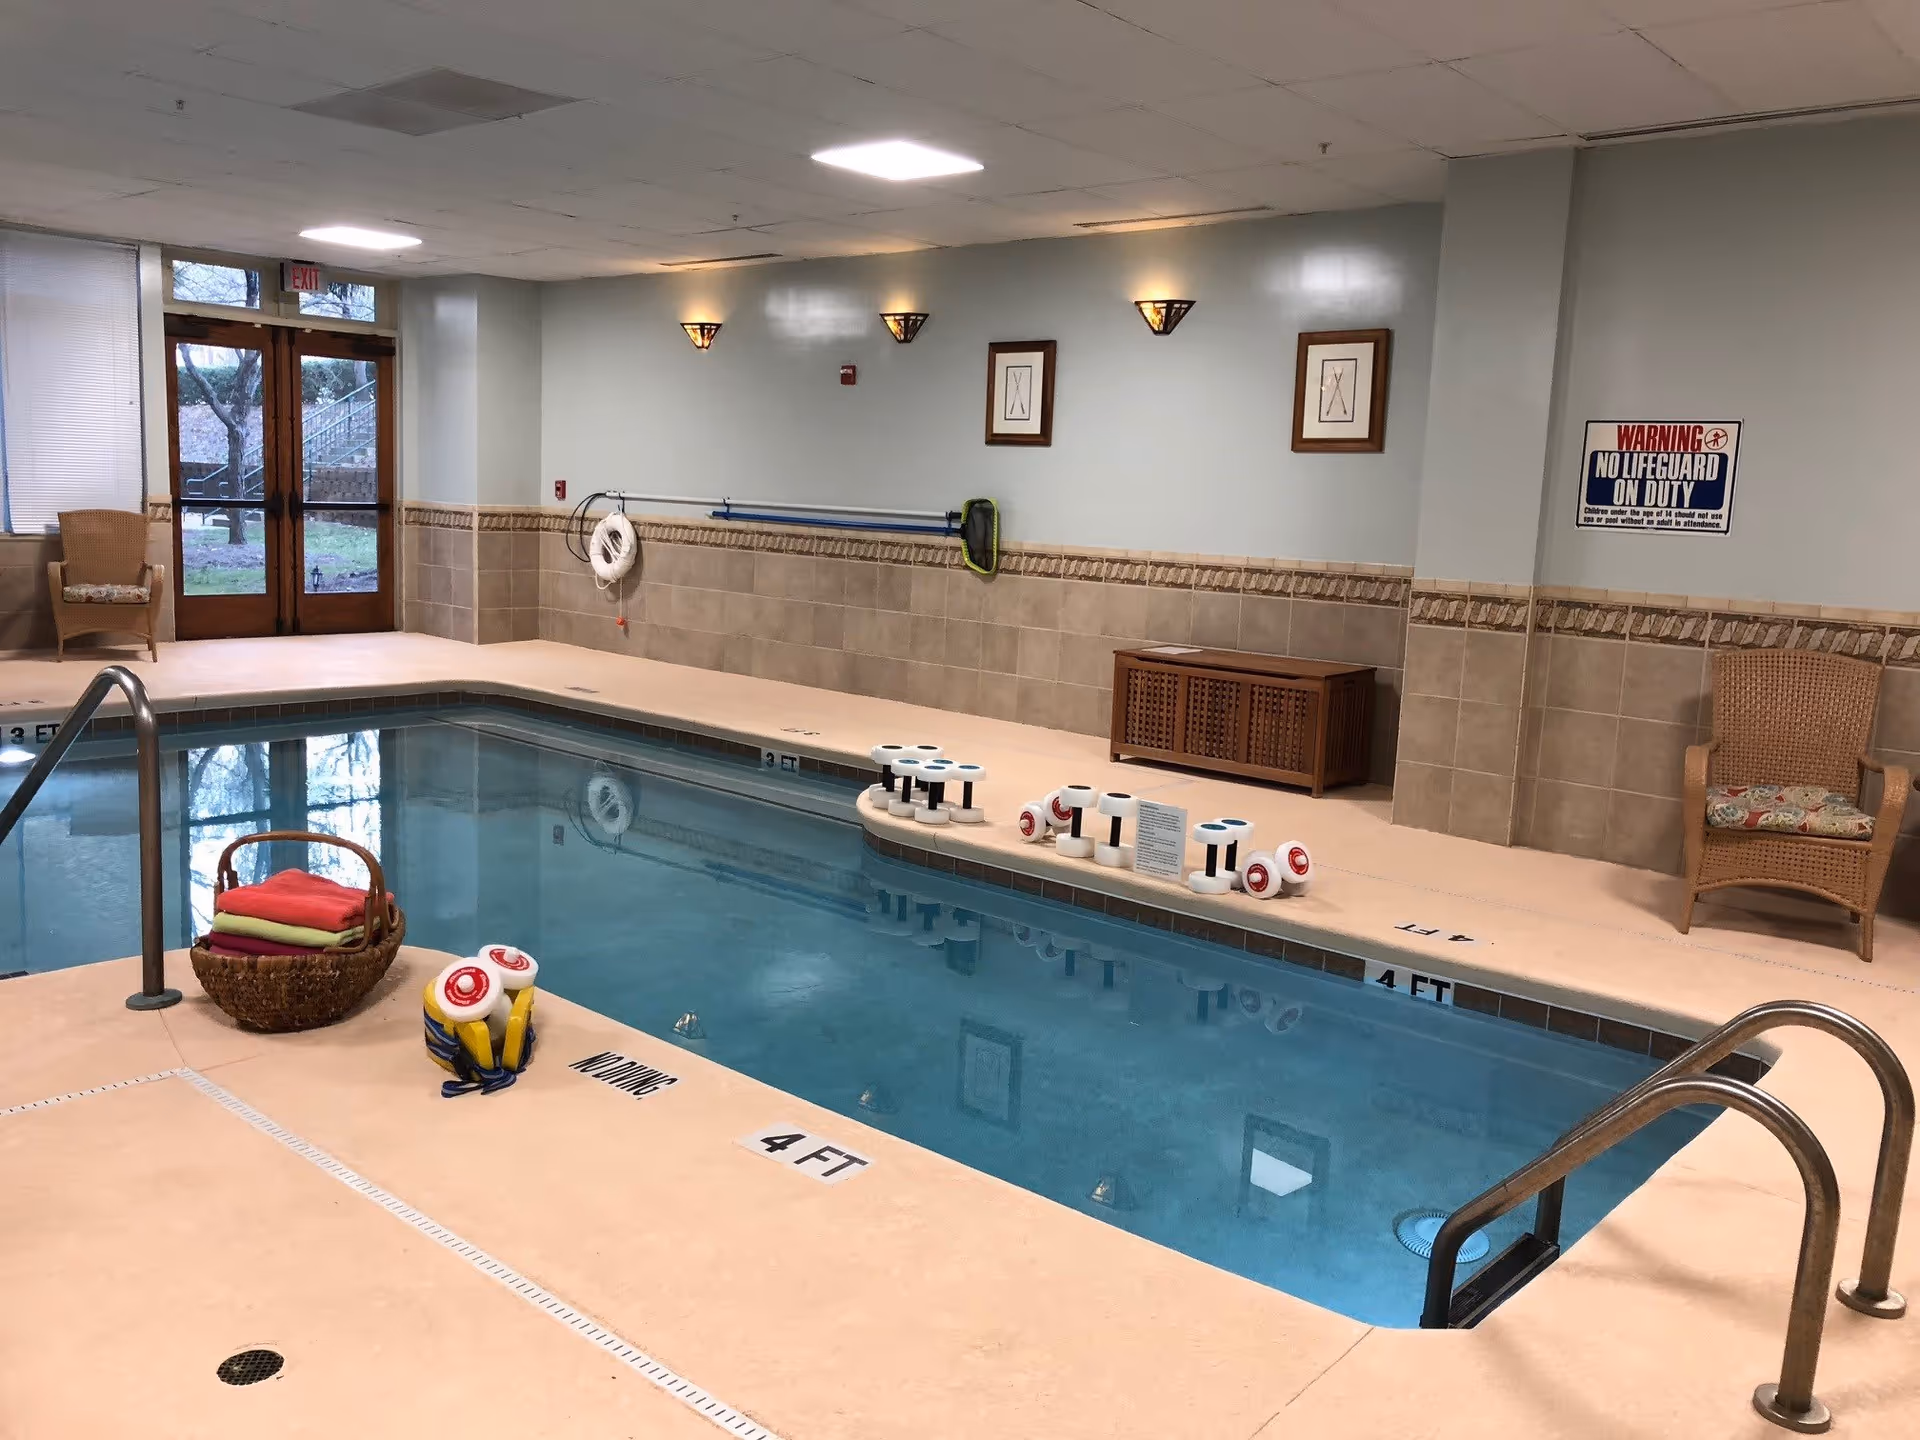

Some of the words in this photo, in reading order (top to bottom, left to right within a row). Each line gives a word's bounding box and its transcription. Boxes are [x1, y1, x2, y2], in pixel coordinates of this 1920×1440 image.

[292, 266, 319, 290] EXIT
[1617, 424, 1704, 453] WARNING
[1595, 452, 1621, 479] NO
[1622, 452, 1720, 481] LIFEGUARD
[1613, 479, 1639, 506] ON
[1644, 480, 1695, 508] DUTY
[1584, 507, 1608, 515] Children
[1610, 508, 1627, 516] under
[1643, 510, 1654, 518] age
[1620, 517, 1644, 525] without
[1657, 518, 1672, 526] adult
[1683, 520, 1722, 529] attendance.
[1394, 923, 1440, 936] FT
[1376, 969, 1397, 989] 4
[1411, 973, 1451, 1002] FT
[568, 1051, 624, 1073] NO
[760, 1133, 807, 1153] 4
[793, 1145, 869, 1177] FT
